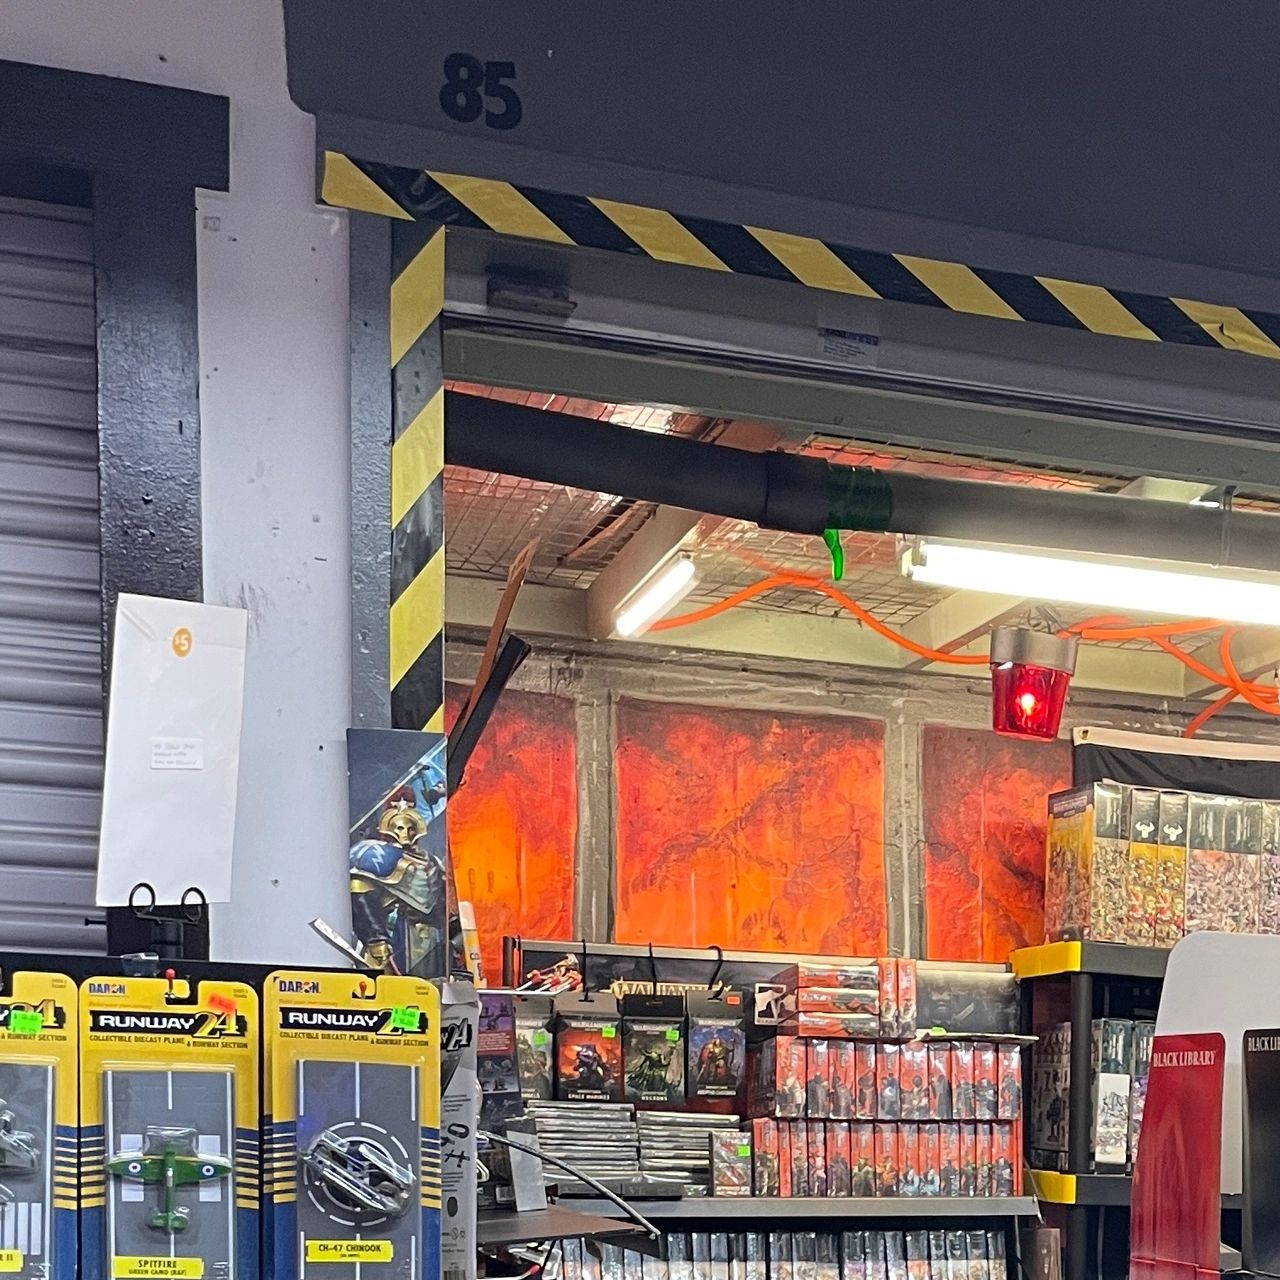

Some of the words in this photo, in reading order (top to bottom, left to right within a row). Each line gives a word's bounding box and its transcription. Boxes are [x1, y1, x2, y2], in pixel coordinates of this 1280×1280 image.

[439, 52, 523, 130] 85
[88, 982, 126, 994] DARON
[279, 980, 320, 993] DARON
[99, 1015, 195, 1030] RUNWAY
[193, 1009, 240, 1039] 24
[288, 1011, 379, 1027] RUNWAY
[89, 1034, 132, 1043] COLLECTIBLE
[134, 1035, 163, 1043] DIECAST
[164, 1036, 186, 1044] PLANE
[1247, 1036, 1269, 1052] BLACK
[1153, 1051, 1178, 1067] BLACK
[1179, 1050, 1217, 1066] LIBRARY
[318, 1244, 345, 1253] CH-47
[346, 1244, 382, 1253] CHINOOK
[137, 1259, 177, 1269] SPITFIRE
